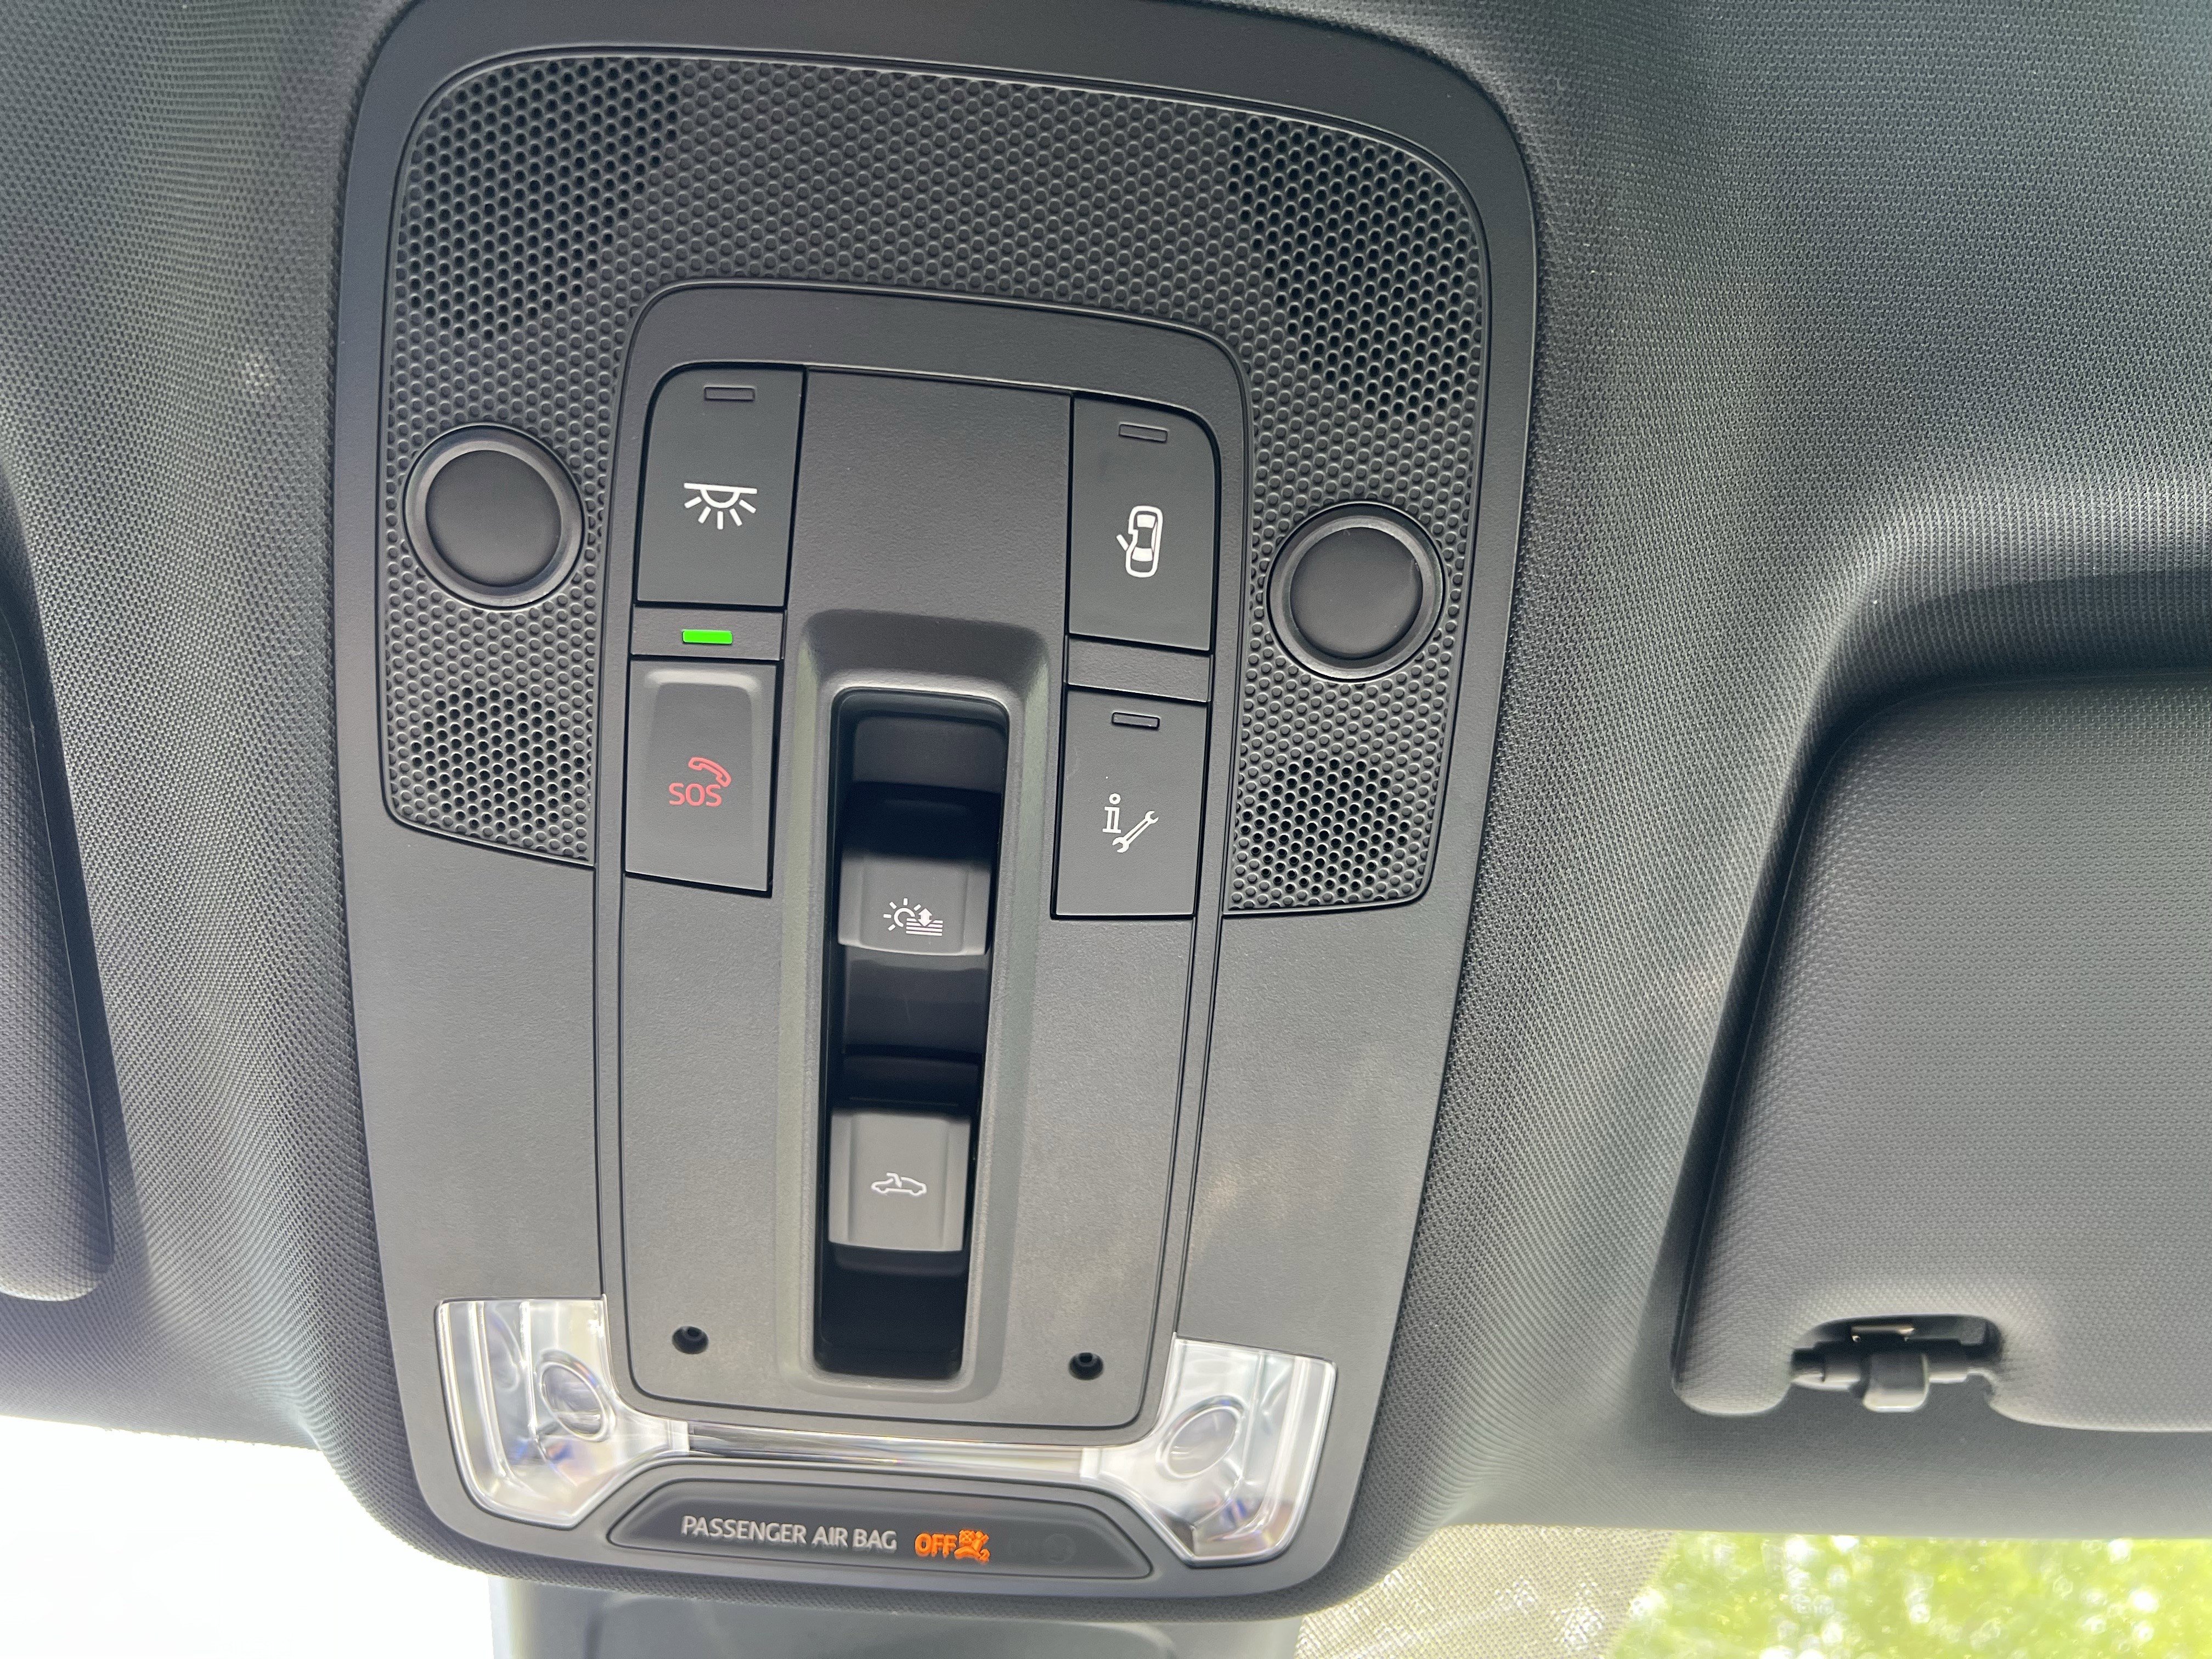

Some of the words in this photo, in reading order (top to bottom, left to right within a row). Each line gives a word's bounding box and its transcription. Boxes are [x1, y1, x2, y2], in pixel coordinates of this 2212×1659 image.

[668, 782, 723, 807] SOS
[680, 1515, 807, 1544] PASSENGER
[811, 1525, 849, 1548] AIR
[852, 1528, 898, 1552] BAG
[915, 1532, 958, 1558] OFF
